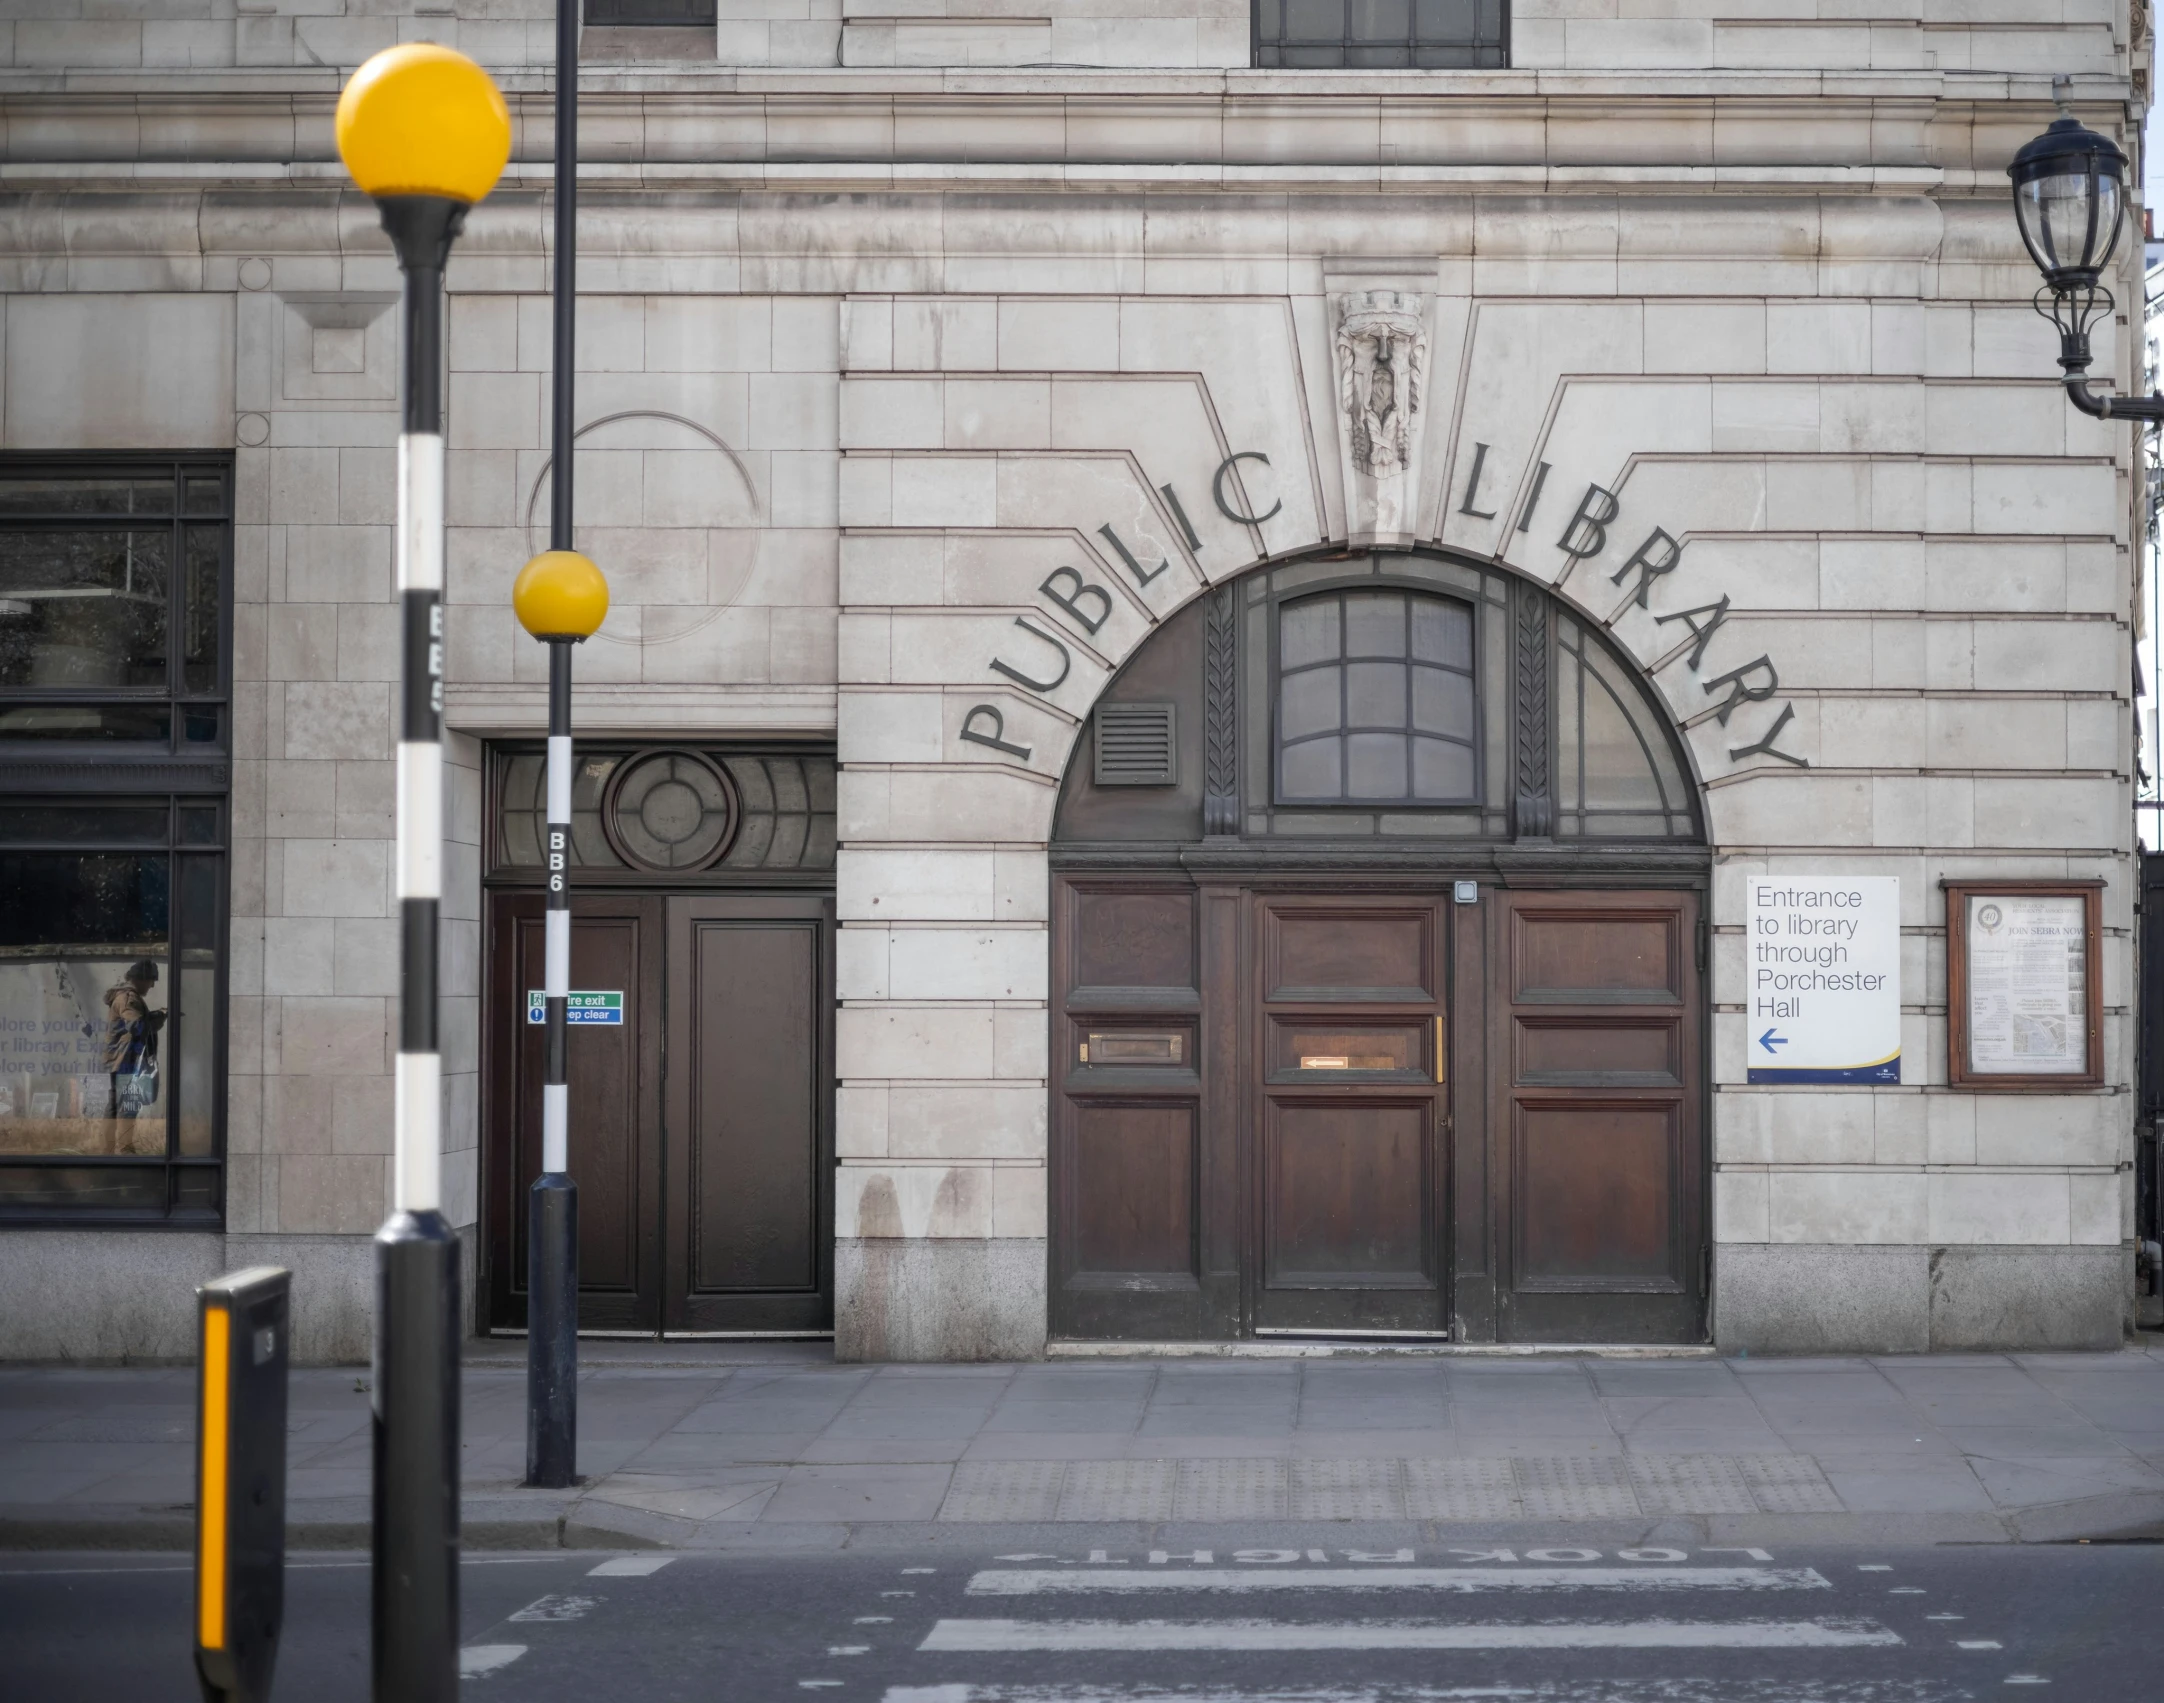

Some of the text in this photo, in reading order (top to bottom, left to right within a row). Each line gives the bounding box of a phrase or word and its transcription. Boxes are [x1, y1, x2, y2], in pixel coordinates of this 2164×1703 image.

[960, 442, 1810, 770] PUBLIC LIBRARY
[549, 832, 565, 892] BB6
[1757, 886, 1862, 907] Entrance
[1756, 914, 1859, 940] to library
[2008, 927, 2028, 936] JOIN
[2030, 927, 2060, 935] SEBRA
[1756, 941, 1848, 968] through
[1757, 969, 1887, 991] Porchester
[567, 995, 606, 1006] ire exit
[1757, 997, 1800, 1018] Hall
[584, 1010, 609, 1019] clear
[0, 1017, 36, 1032] lore
[42, 1020, 80, 1035] your
[13, 1038, 70, 1055] library
[0, 1059, 36, 1073] lore
[42, 1062, 81, 1076] your
[1057, 1547, 1774, 1564] LOOK RIGHT
